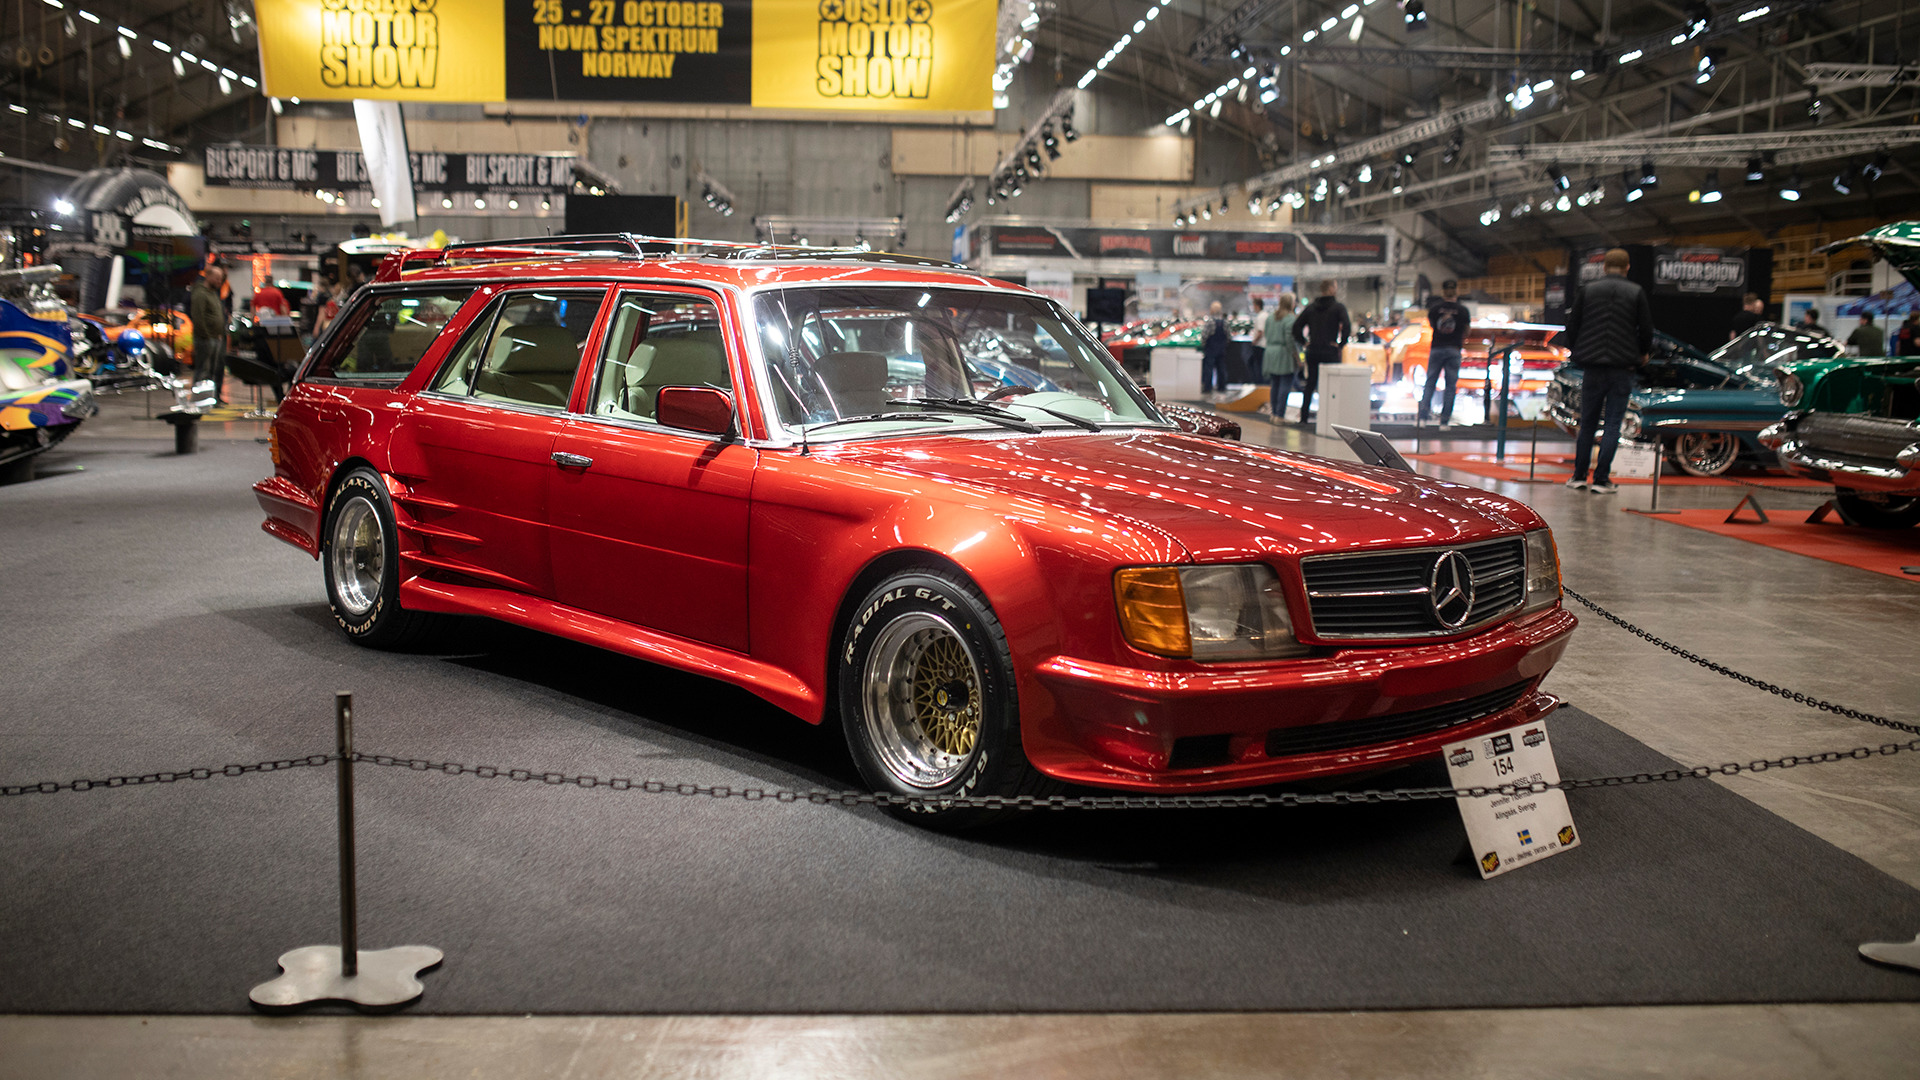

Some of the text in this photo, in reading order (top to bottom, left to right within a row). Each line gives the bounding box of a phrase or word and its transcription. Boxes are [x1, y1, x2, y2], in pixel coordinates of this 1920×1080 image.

[321, 9, 439, 49] MOTOR
[533, 0, 563, 24] 25
[589, 0, 616, 25] 27
[623, 1, 724, 28] OCTOBER
[538, 24, 719, 54] NOVA SPEKTRUM
[819, 20, 934, 59] MOTOR
[320, 44, 439, 89] SHOW
[582, 51, 676, 78] NORWAY
[816, 54, 933, 99] SHOW
[206, 147, 319, 182] BILSPORT & MC
[421, 154, 449, 184] MC
[466, 153, 577, 187] BILSPORT & MC
[846, 587, 958, 665] RADIAL G/T
[1493, 756, 1515, 777] 154
[1517, 801, 1537, 814] Sverige
